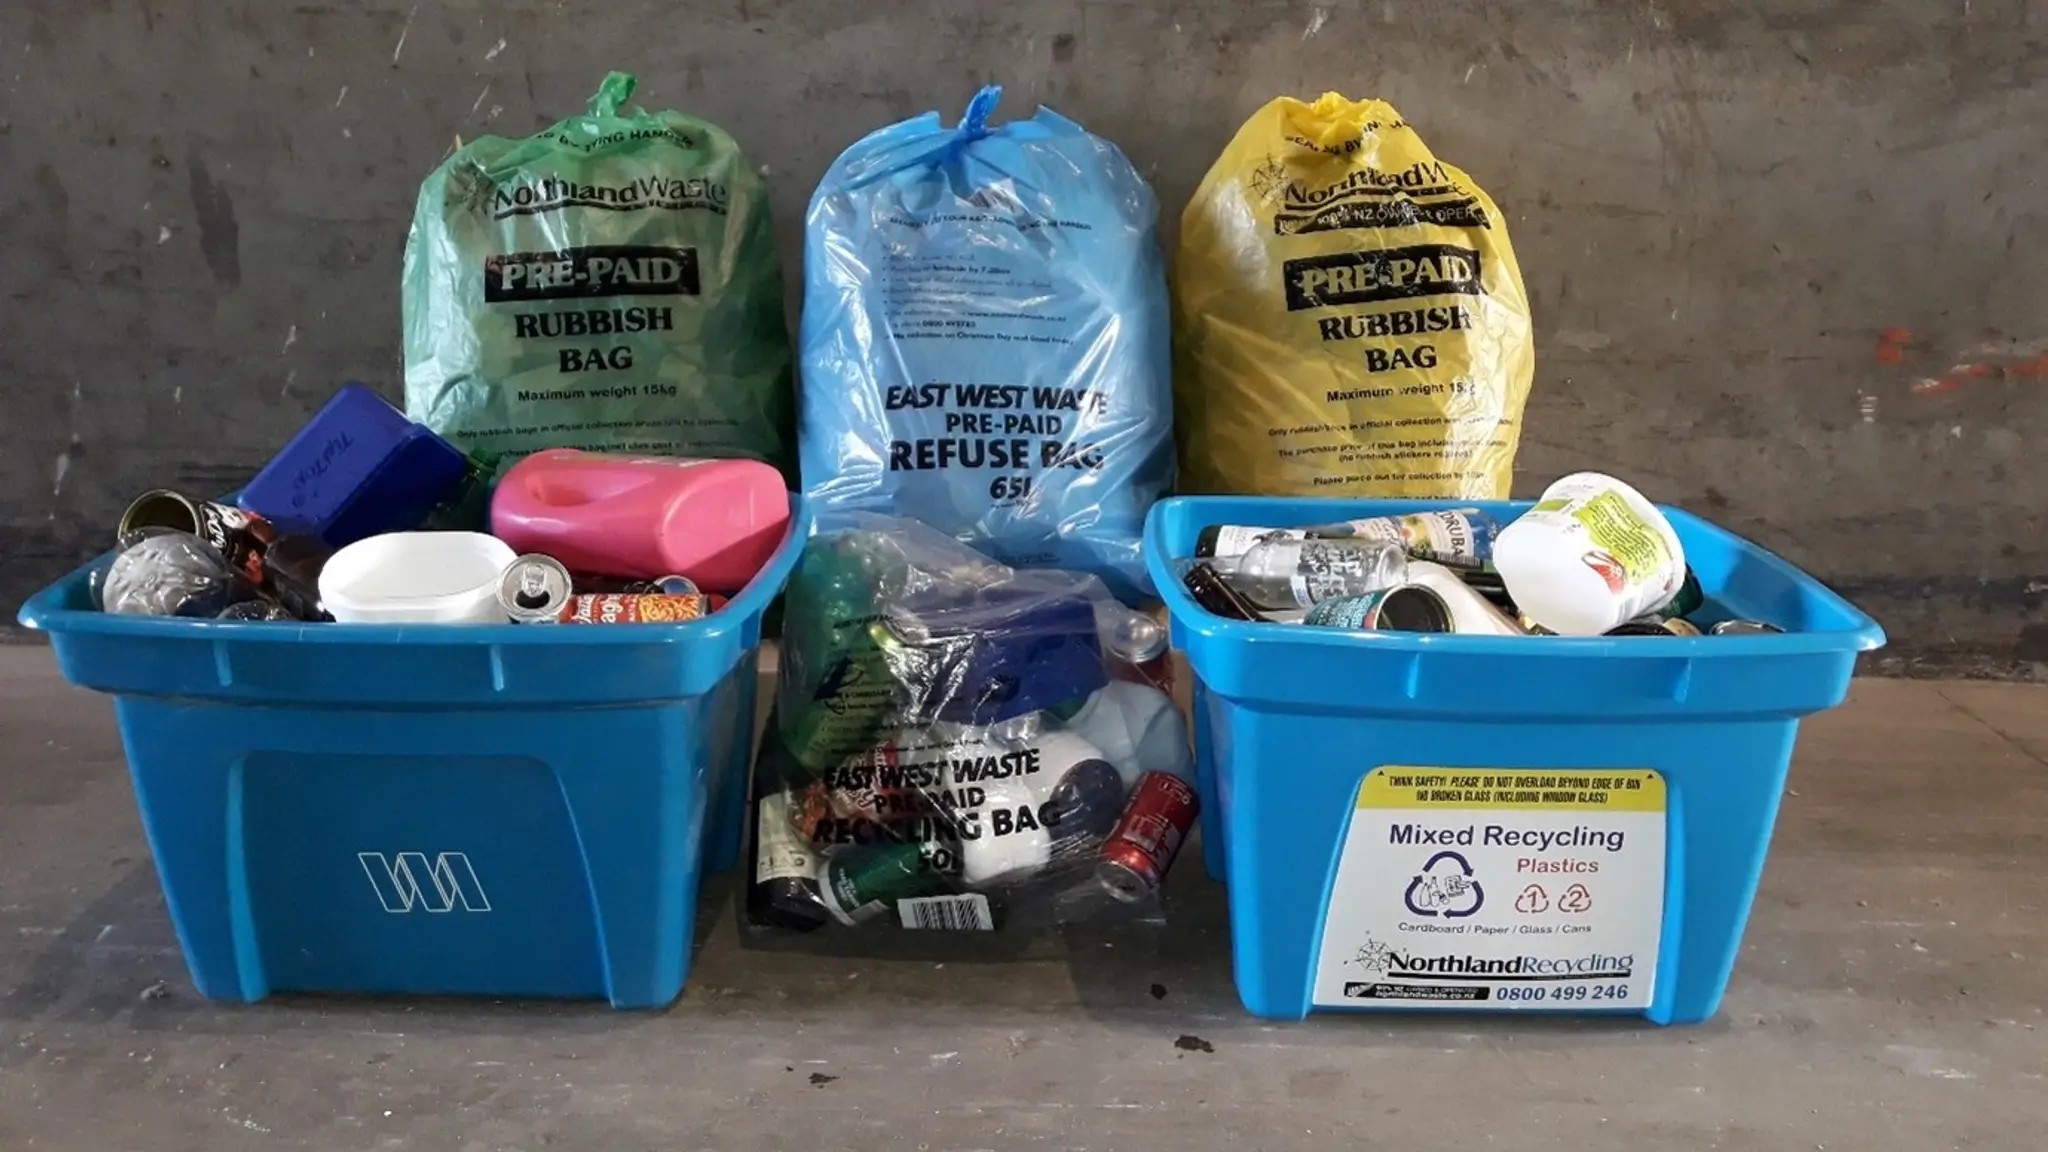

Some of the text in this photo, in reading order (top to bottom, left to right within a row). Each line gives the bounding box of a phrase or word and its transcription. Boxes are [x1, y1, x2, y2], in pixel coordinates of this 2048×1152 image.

[1353, 207, 1374, 220] NZ
[501, 257, 683, 291] PRE-PAID
[1302, 255, 1473, 297] PRE-PAID
[514, 307, 674, 338] RUBBISH
[1317, 304, 1472, 341] RUBBISH
[558, 347, 633, 373] BAG
[1365, 345, 1437, 373] BAG
[517, 384, 677, 402] Maximum weight 15kg
[885, 383, 1108, 414] EAST WEST WASTE
[1326, 387, 1394, 402] Maximum
[946, 412, 1063, 436] PRE-PAID
[1268, 428, 1287, 437] Only
[890, 438, 1105, 471] REFUSE BAG
[823, 749, 1040, 790] EAST WEST WASTE
[1389, 776, 1413, 787] THINK
[1450, 776, 1480, 788] PLEASE
[1483, 777, 1495, 788] DO
[1496, 777, 1512, 788] NOT
[1514, 777, 1556, 788] OVERLOAD
[1557, 777, 1590, 788] BEYOND
[1592, 778, 1612, 789] EDGE
[1614, 778, 1625, 789] OF
[1626, 778, 1641, 790] BIN
[1416, 790, 1429, 801] NO
[1431, 790, 1462, 801] BROKEN
[1464, 791, 1491, 802] GLASS
[1542, 792, 1576, 803] WINDOW
[1578, 792, 1608, 804] GLASS)
[813, 801, 1062, 844] RECYCLING BAG
[1390, 824, 1625, 852] Mixed Recycling
[1517, 858, 1599, 873] Plastics
[1528, 890, 1583, 907] 1 2
[1398, 922, 1465, 934] Cardboard
[1474, 924, 1509, 936] Paper
[1519, 924, 1552, 935] Glass
[1562, 923, 1592, 934] Cans
[1388, 953, 1634, 974] NorthlandRecycling
[1497, 984, 1629, 1000] 0800 499 246
